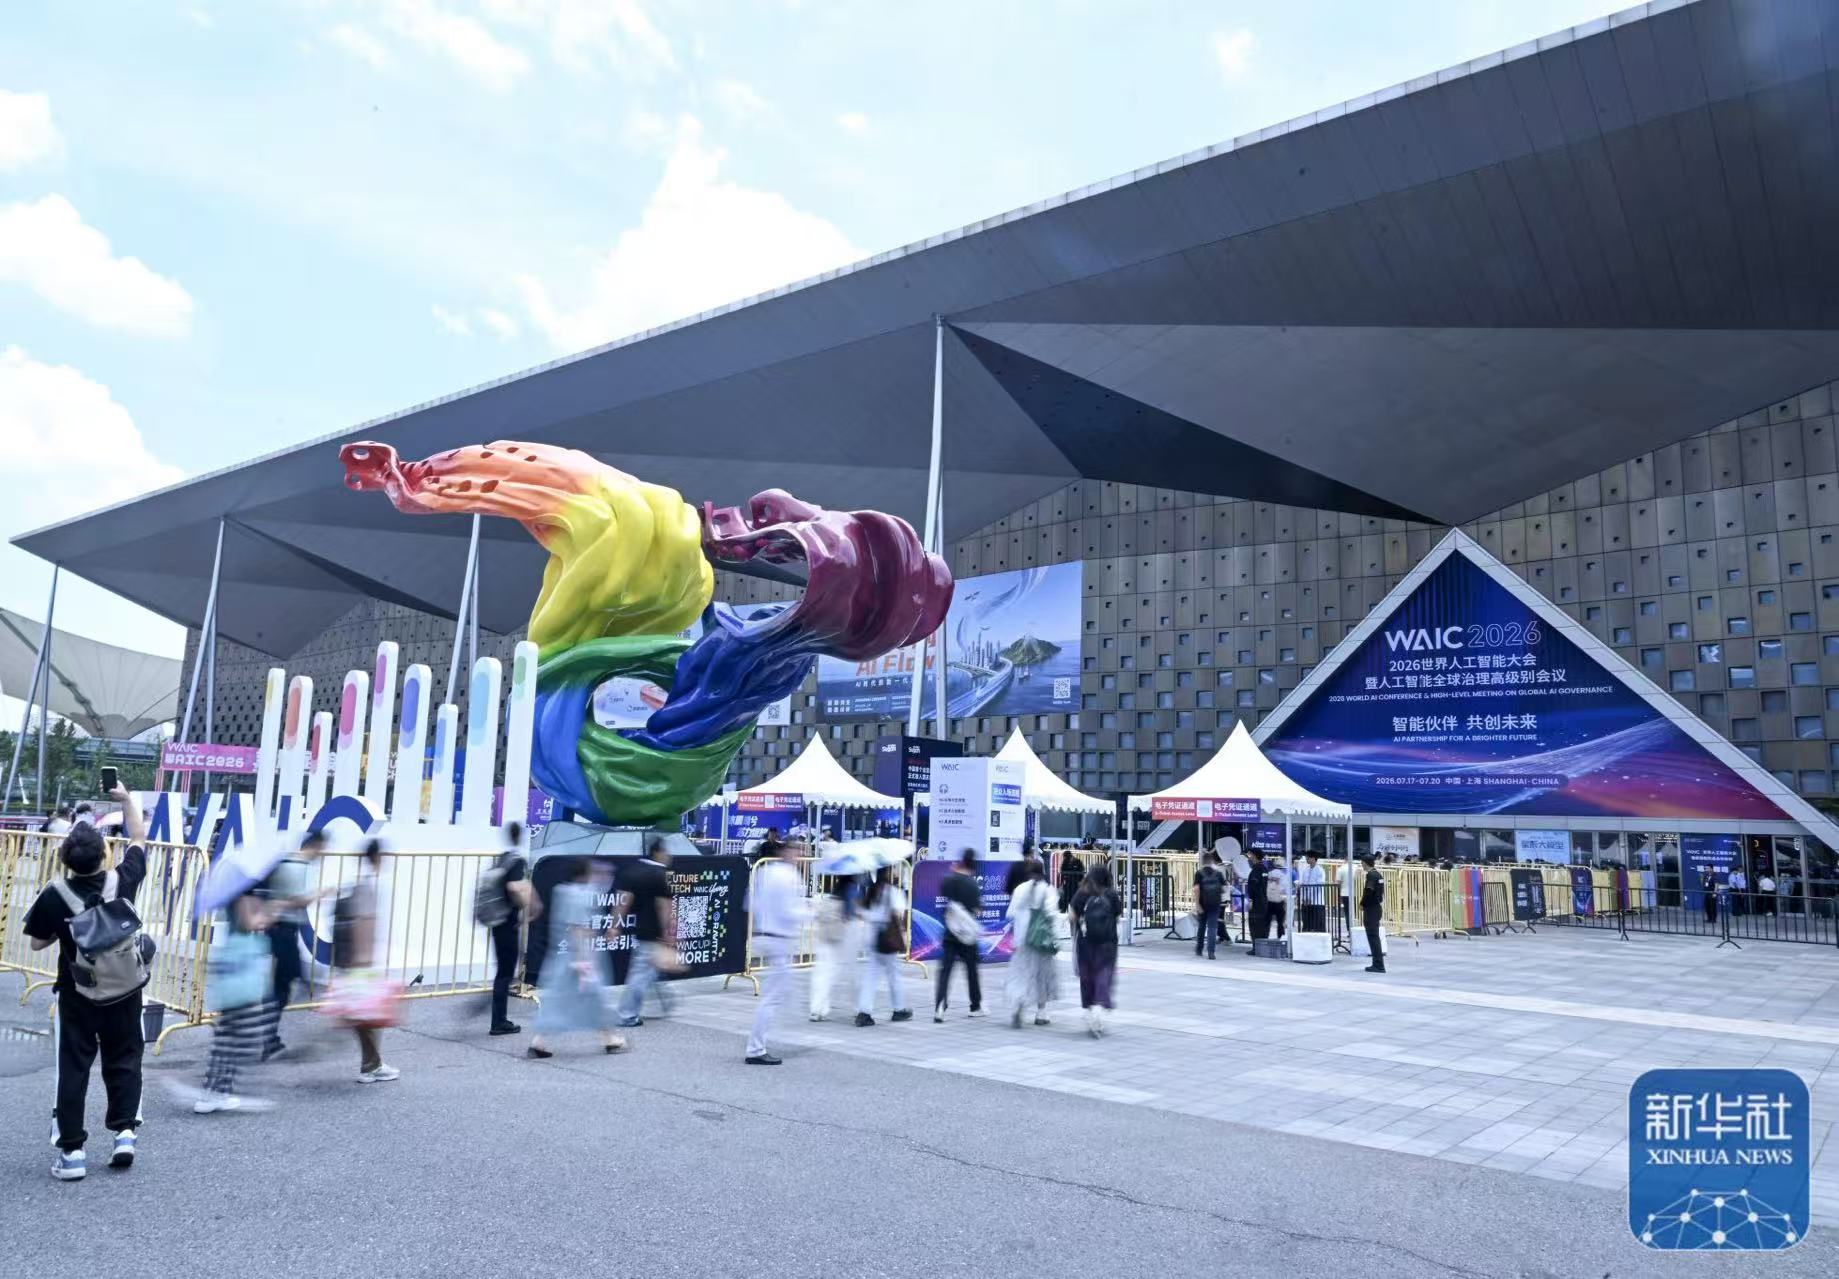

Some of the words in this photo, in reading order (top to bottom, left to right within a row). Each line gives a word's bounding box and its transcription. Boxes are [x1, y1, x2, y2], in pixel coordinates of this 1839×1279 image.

[1384, 627, 1464, 651] WAIC
[1467, 621, 1542, 648] 2026
[1389, 653, 1537, 672] 2026世界人工智能大会
[1365, 668, 1567, 690] 暨人工智能全球治理高级别会议
[1378, 692, 1422, 700] CONFERENCE
[1430, 690, 1471, 698] HIGH-LEVEL
[1558, 686, 1613, 694] GOVERNANCE
[1392, 715, 1458, 732] 智能伙伴
[1466, 714, 1537, 730] 共创未来
[168, 742, 198, 752] WAIC
[942, 763, 960, 771] WAIC
[1376, 777, 1440, 785] 2026.07.17-07.20
[1155, 801, 1195, 810] 电子凭证通道
[1214, 802, 1258, 811] 电子凭证通道
[670, 885, 691, 894] TECH
[597, 893, 628, 907] WAIC
[583, 913, 637, 930] 官方入口
[677, 940, 698, 950] WAIC
[698, 940, 710, 949] UP
[676, 950, 710, 964] MORE
